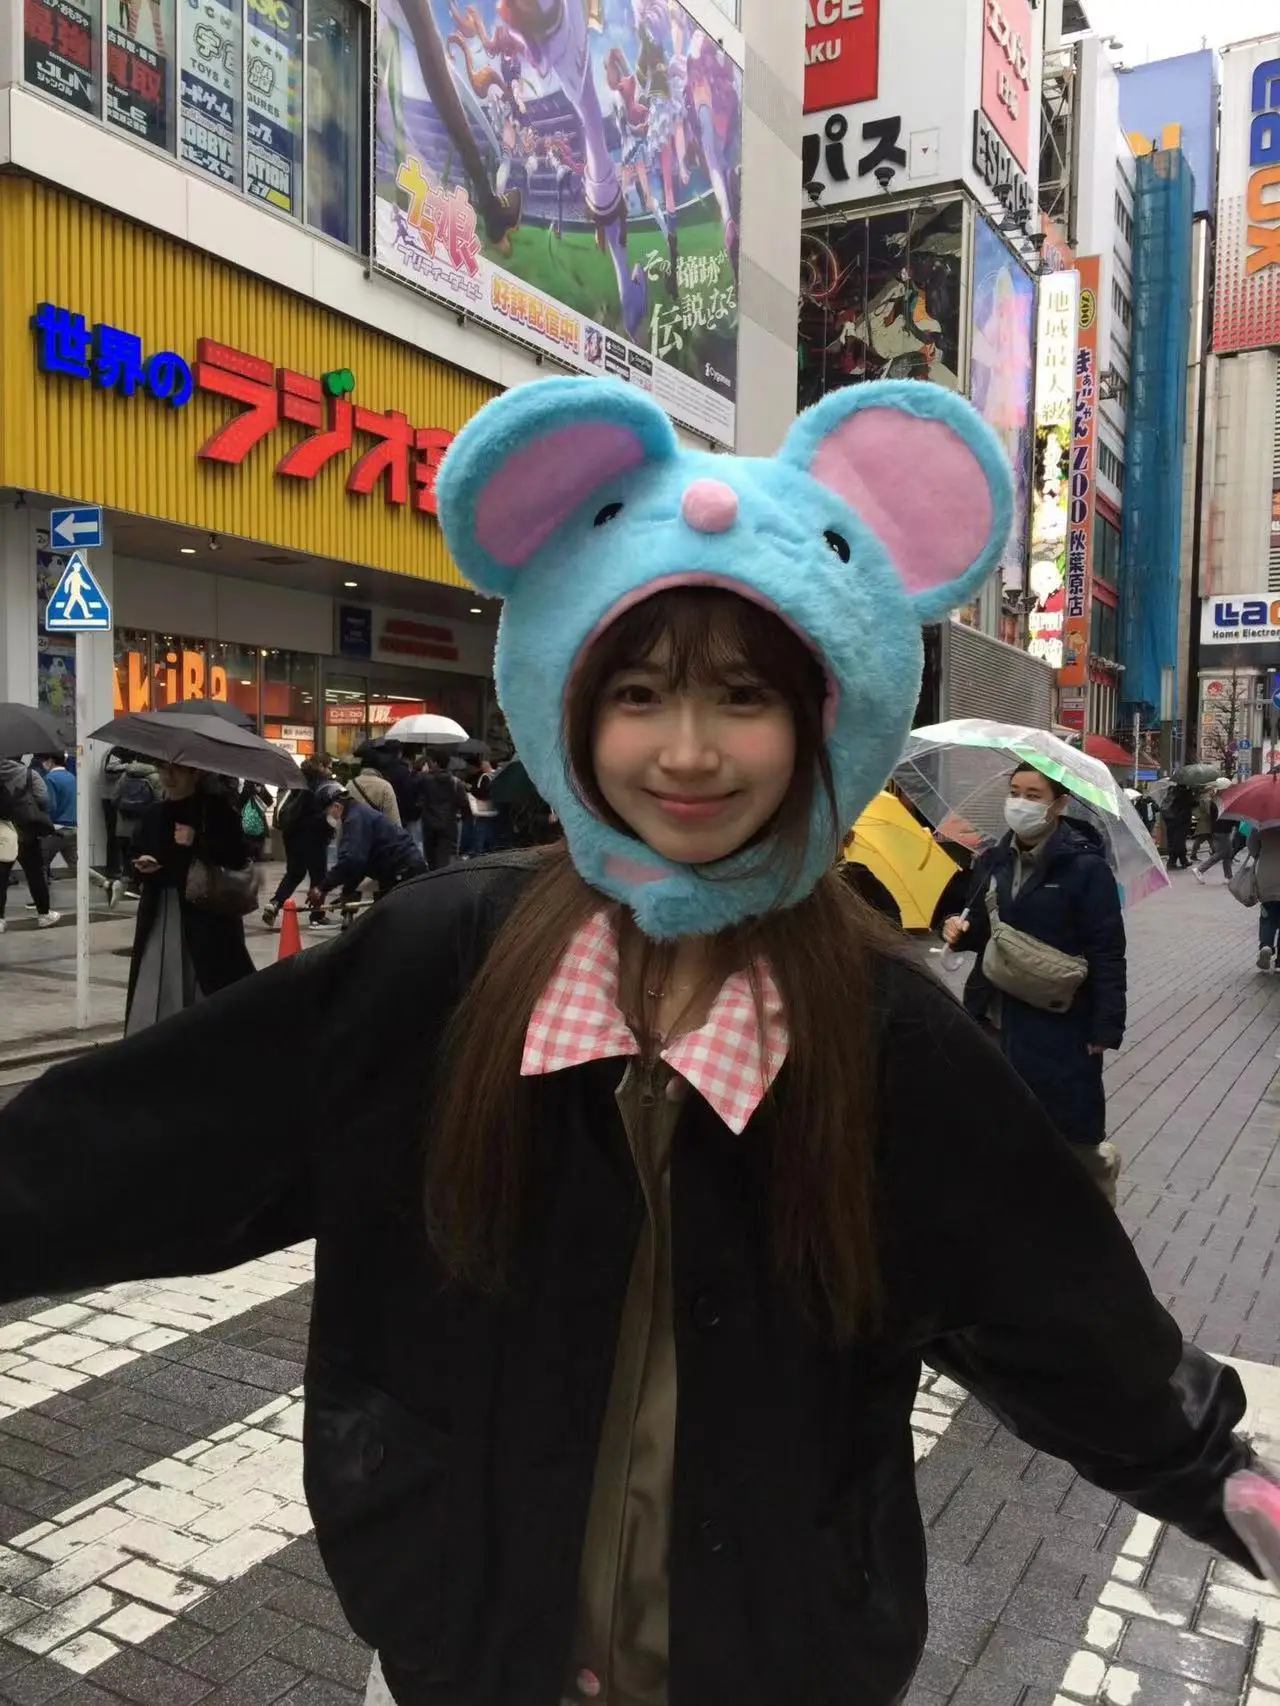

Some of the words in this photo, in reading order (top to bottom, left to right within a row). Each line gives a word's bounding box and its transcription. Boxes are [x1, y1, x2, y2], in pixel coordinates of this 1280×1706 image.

[648, 286, 737, 360] 伝説となる
[1069, 445, 1090, 526] ZOO
[1212, 630, 1240, 639] Home
